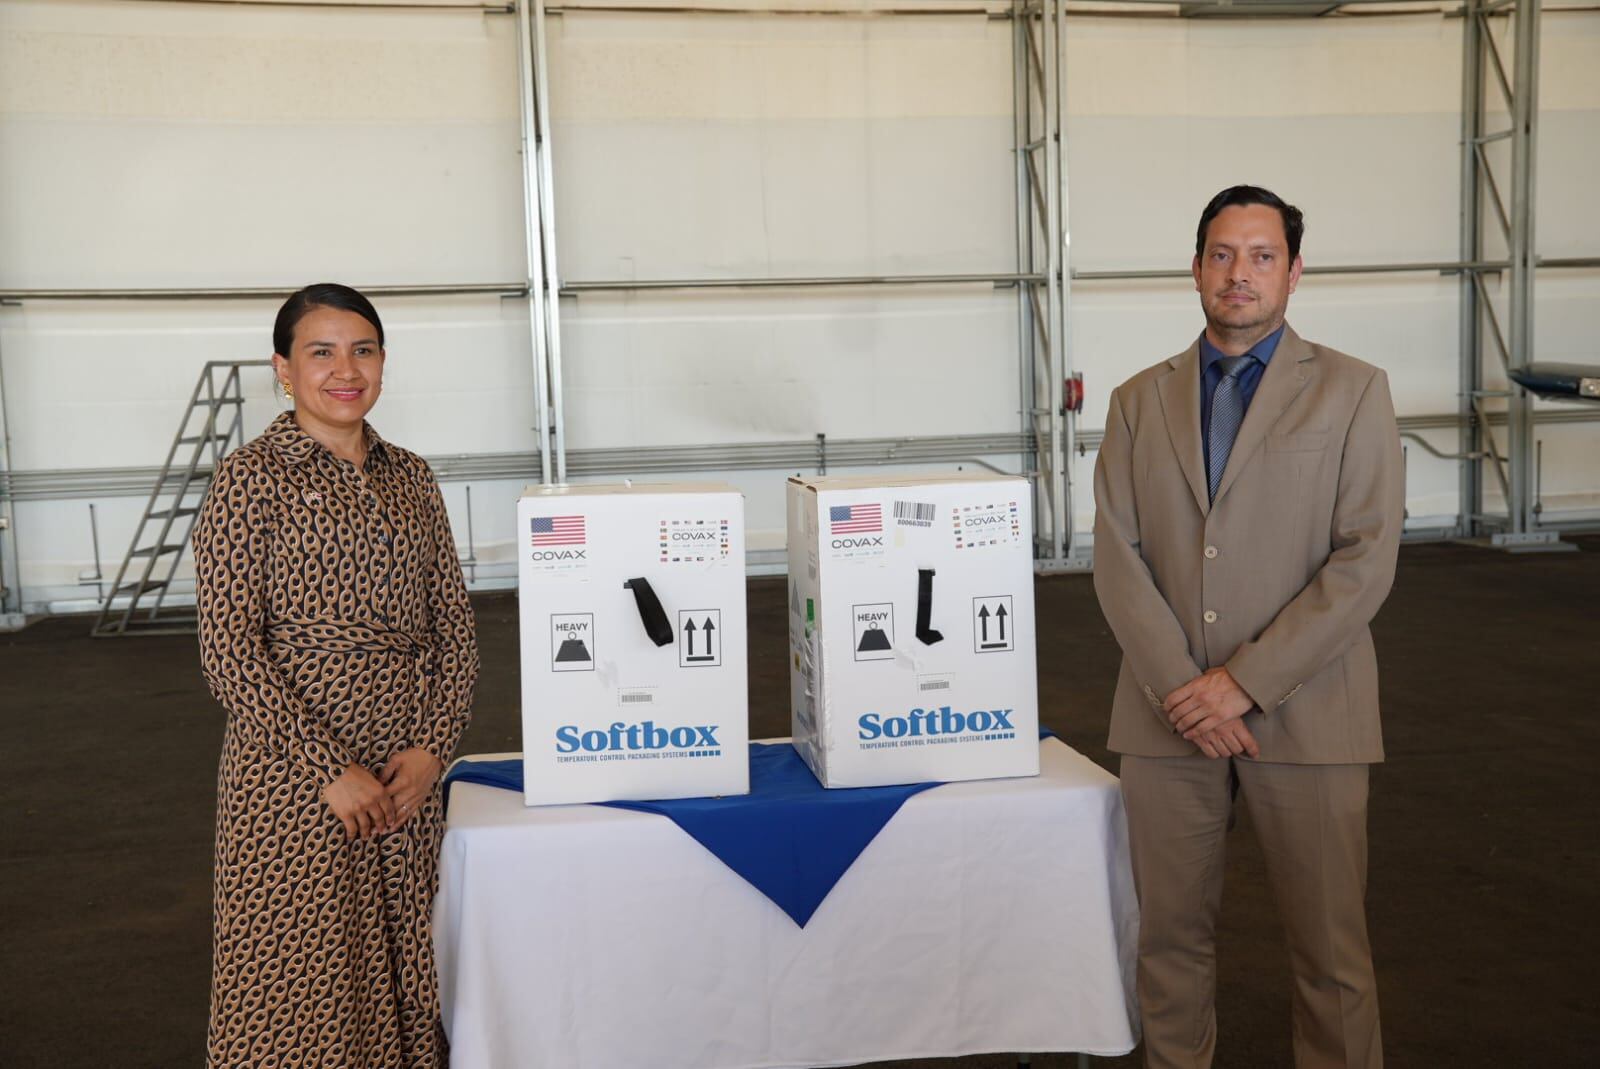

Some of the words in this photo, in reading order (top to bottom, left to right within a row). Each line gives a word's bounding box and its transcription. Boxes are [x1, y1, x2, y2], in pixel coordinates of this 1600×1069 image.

[964, 514, 1006, 527] COVAX
[672, 532, 716, 541] COVAX
[831, 536, 884, 549] COVAX
[531, 549, 587, 561] COVAX
[857, 611, 889, 623] HEAVY
[555, 622, 589, 633] HEAVY
[858, 705, 1015, 741] Softbox
[555, 720, 721, 753] Softbox
[860, 741, 898, 750] TEMPERATURE
[900, 739, 925, 747] CONTROL
[927, 737, 958, 745] PACKAGING
[959, 734, 984, 743] SYSTEMS
[557, 754, 598, 763] TEMPERATURE
[599, 753, 626, 762] CONTROL
[627, 752, 661, 760] PACKAGING
[662, 751, 688, 759] SYSTEMS
